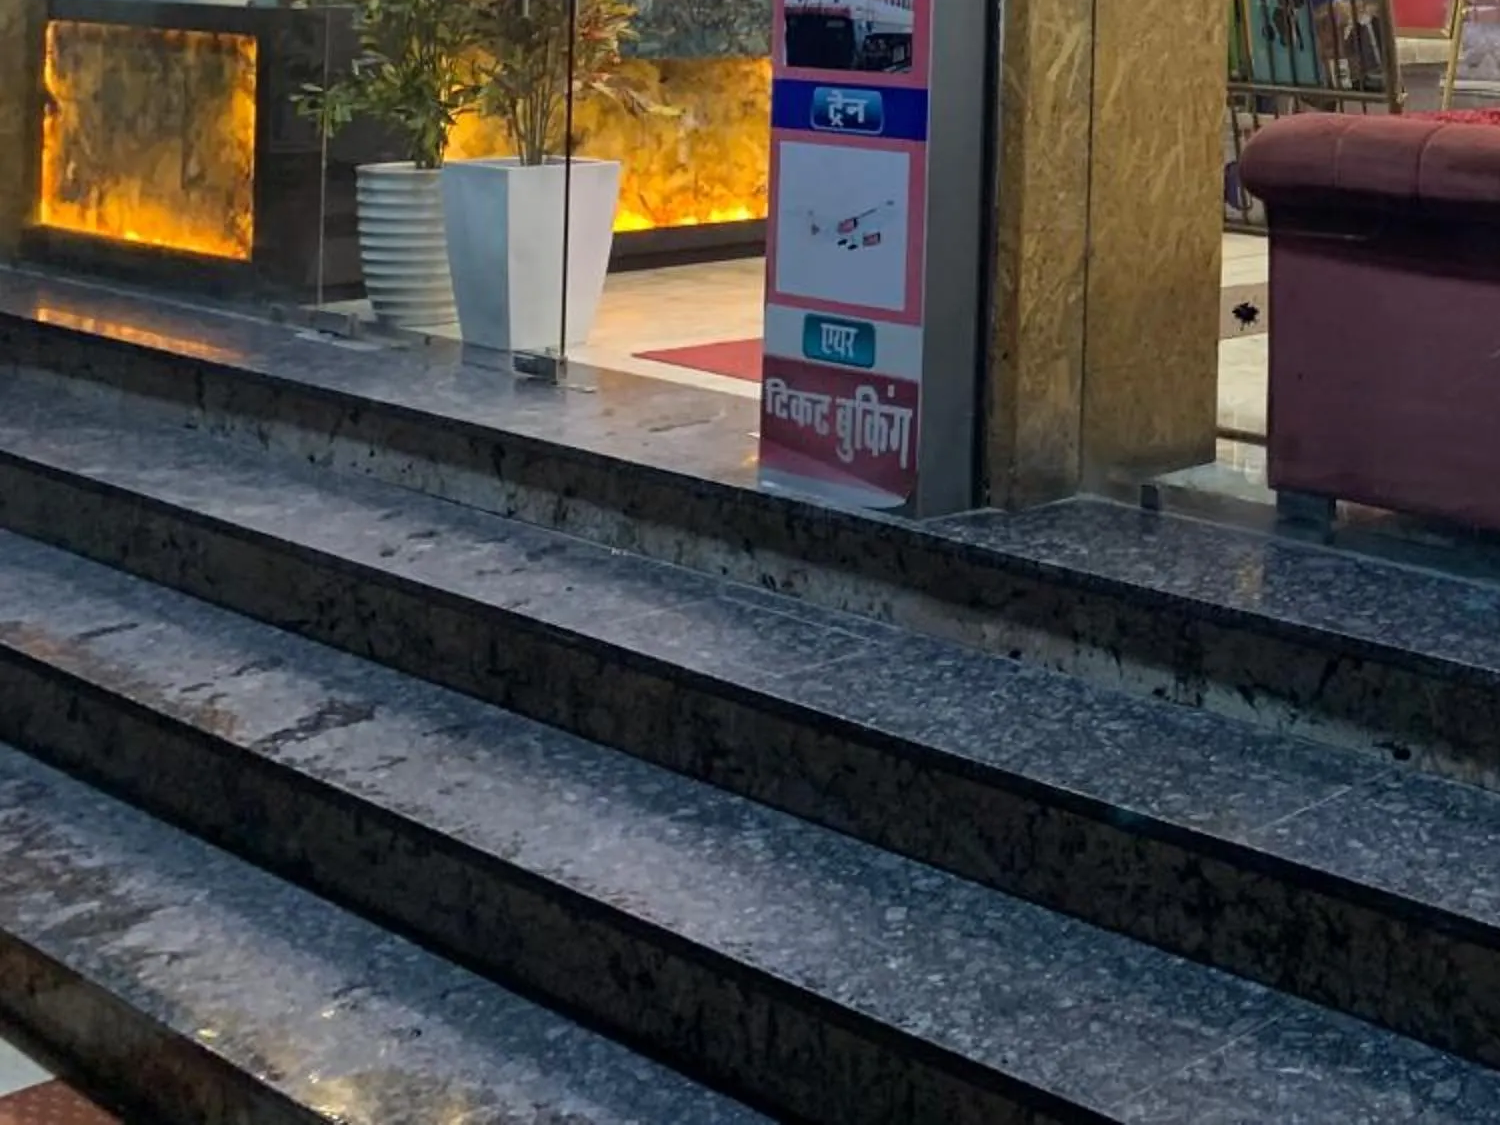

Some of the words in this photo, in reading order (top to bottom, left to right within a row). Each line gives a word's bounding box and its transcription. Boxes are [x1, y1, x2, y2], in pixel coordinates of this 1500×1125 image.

[826, 89, 869, 127] ट्रेन
[820, 322, 859, 359] एयर
[765, 377, 832, 436] टिकट
[835, 384, 913, 470] बुकिंग
